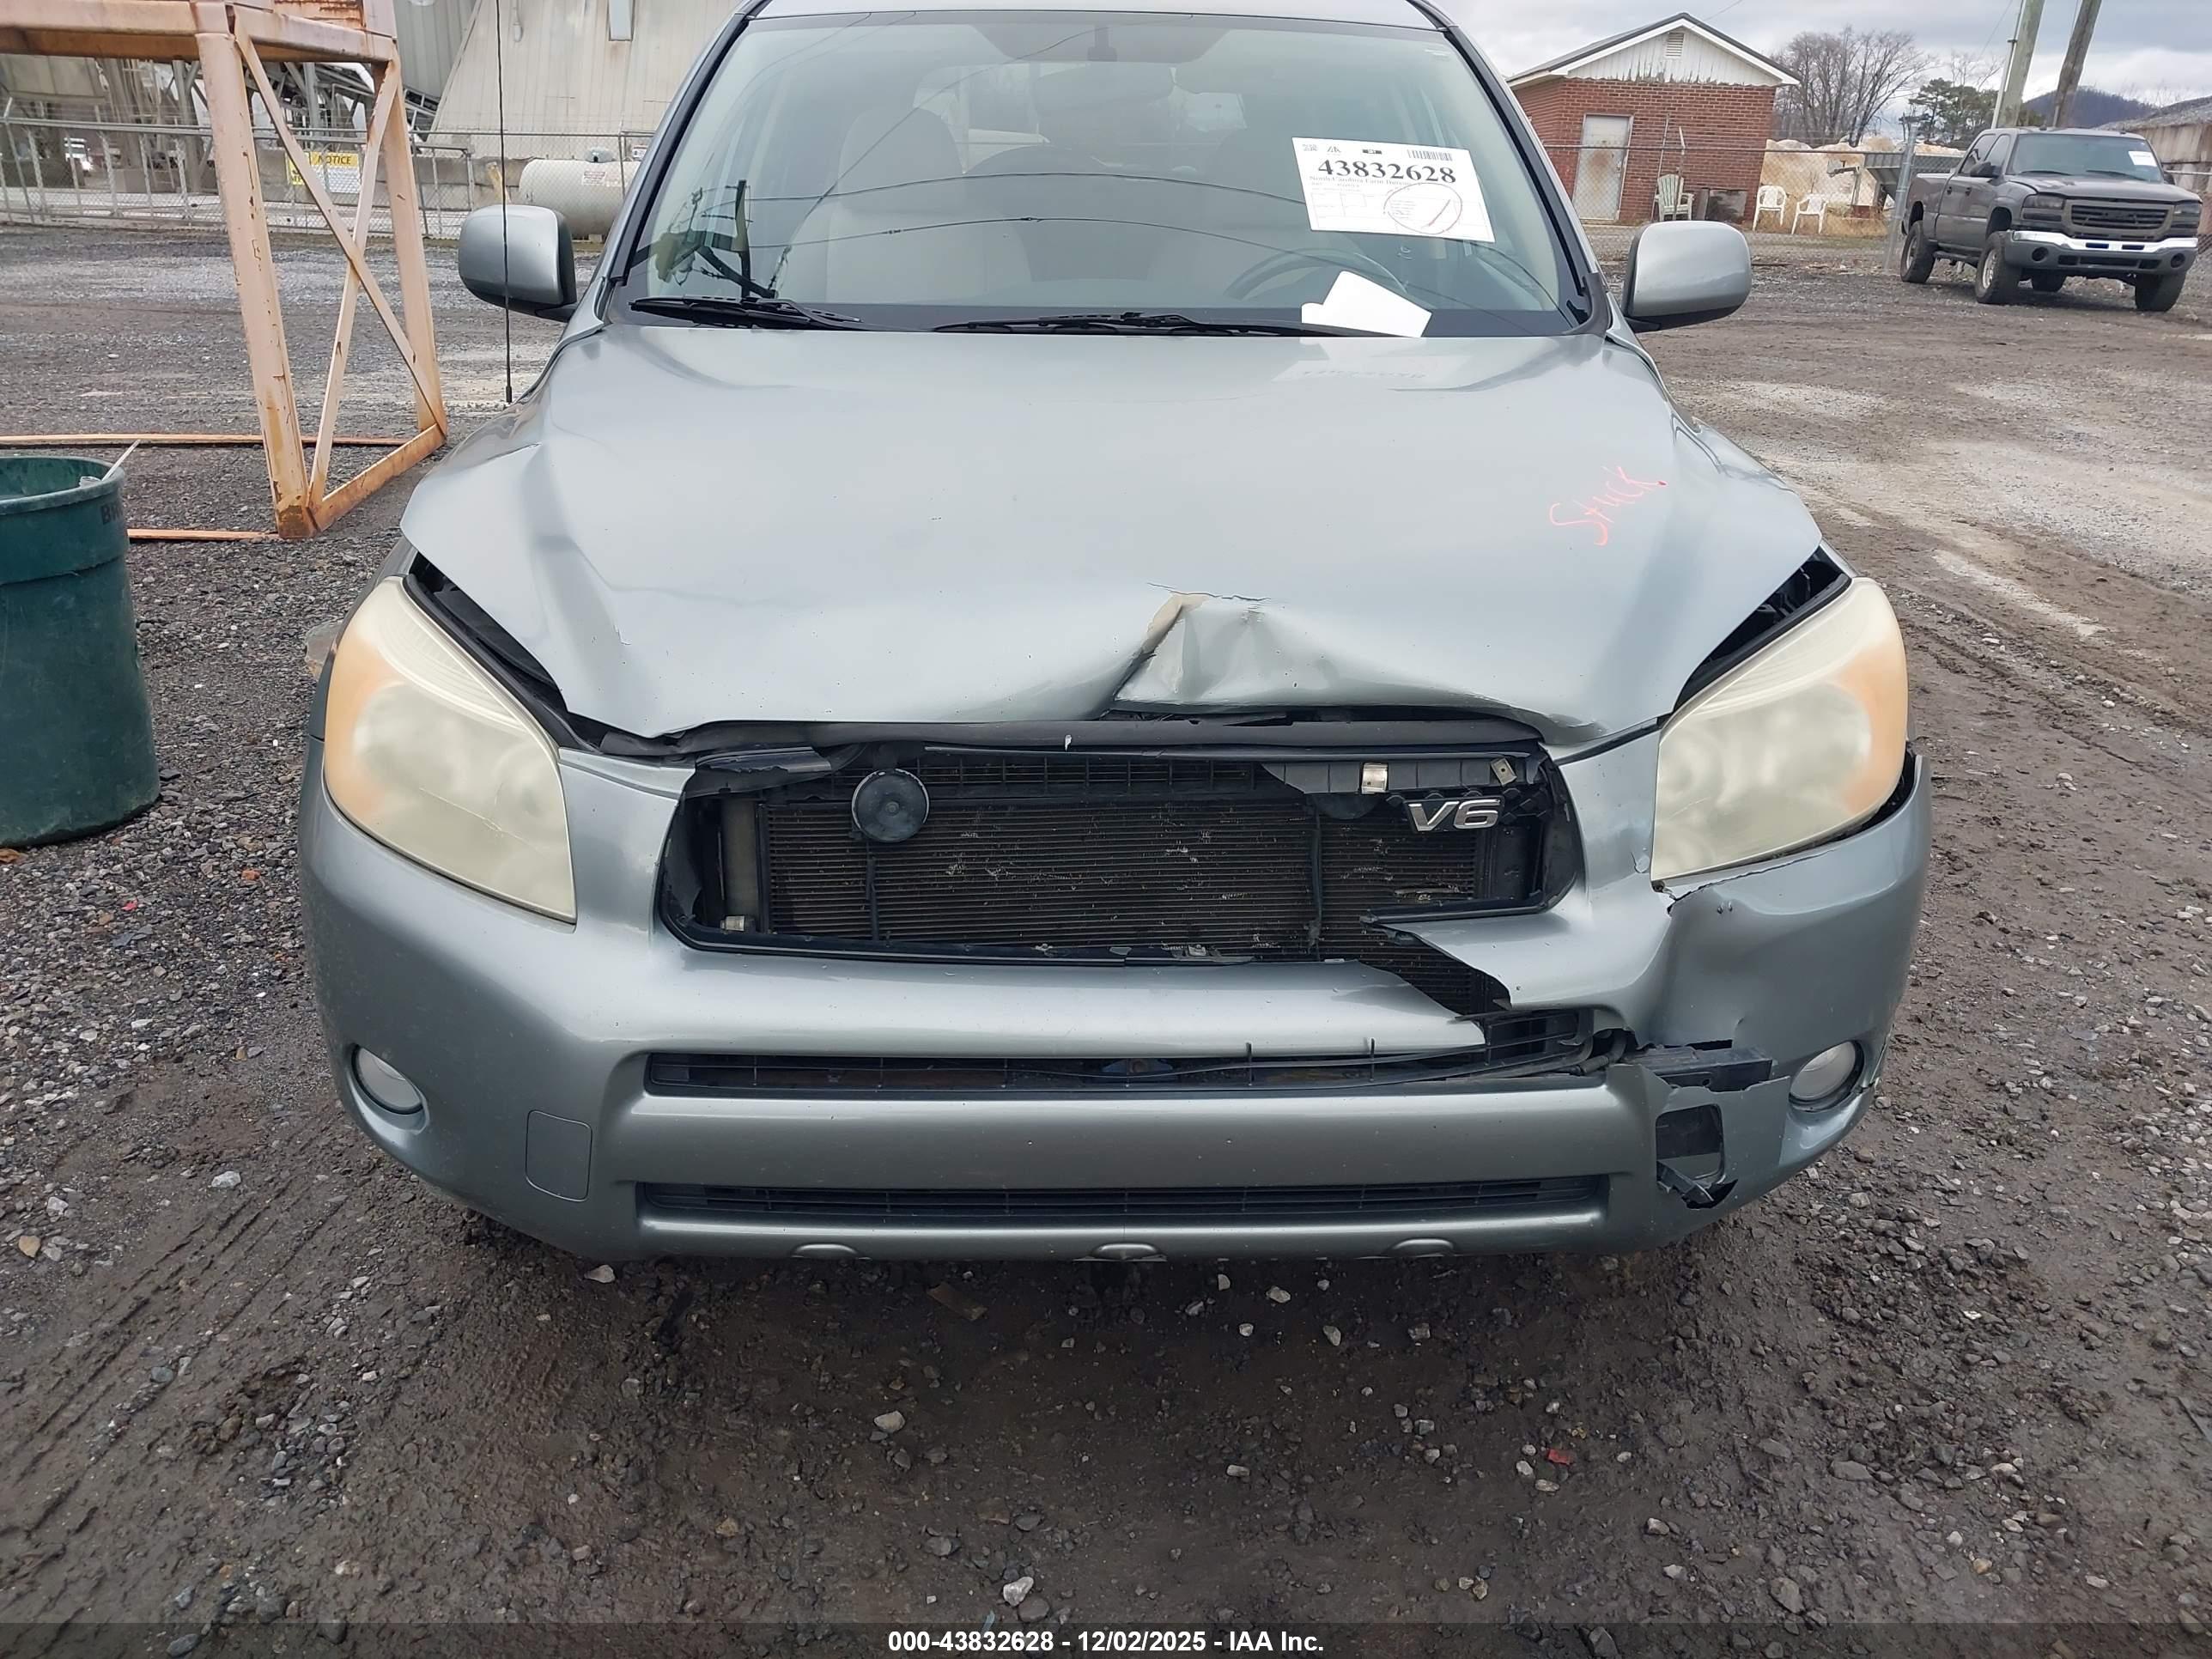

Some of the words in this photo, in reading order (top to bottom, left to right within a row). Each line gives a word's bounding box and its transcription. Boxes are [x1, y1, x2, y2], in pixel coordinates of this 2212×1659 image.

[318, 155, 351, 165] NOTICE
[1318, 159, 1456, 184] 43832628
[1407, 799, 1501, 831] V6
